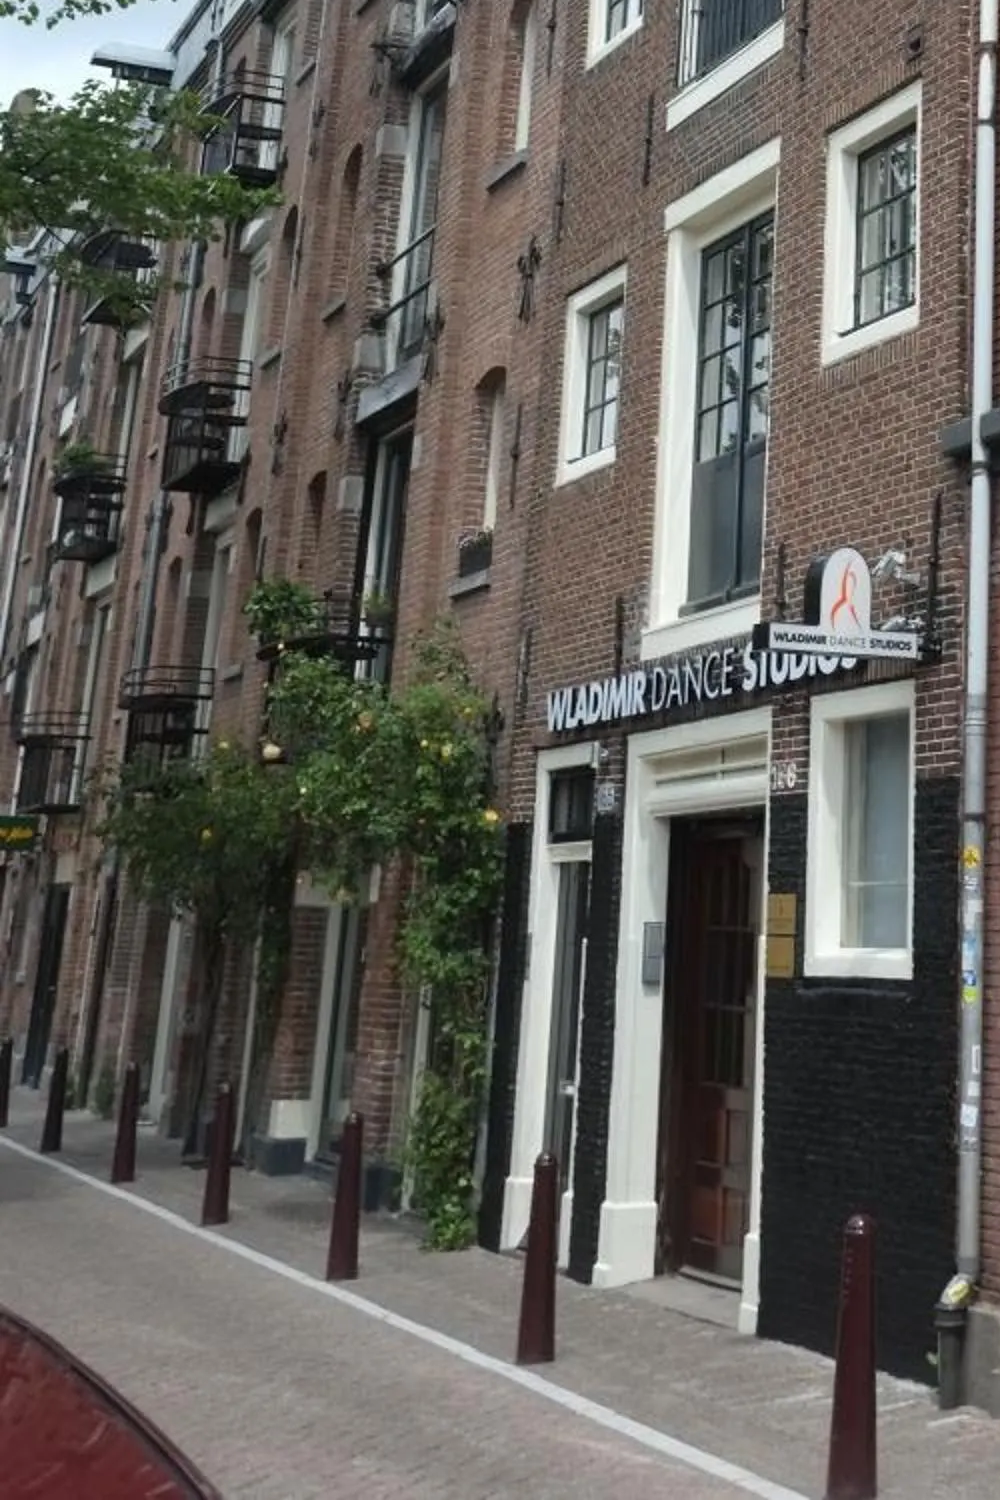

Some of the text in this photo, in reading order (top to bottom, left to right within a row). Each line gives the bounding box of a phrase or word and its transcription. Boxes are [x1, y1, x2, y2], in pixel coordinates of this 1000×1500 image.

[773, 631, 913, 651] WLADIMIR DANCE STUDIOS
[547, 641, 858, 732] WLADIMIR DANCE STUD
